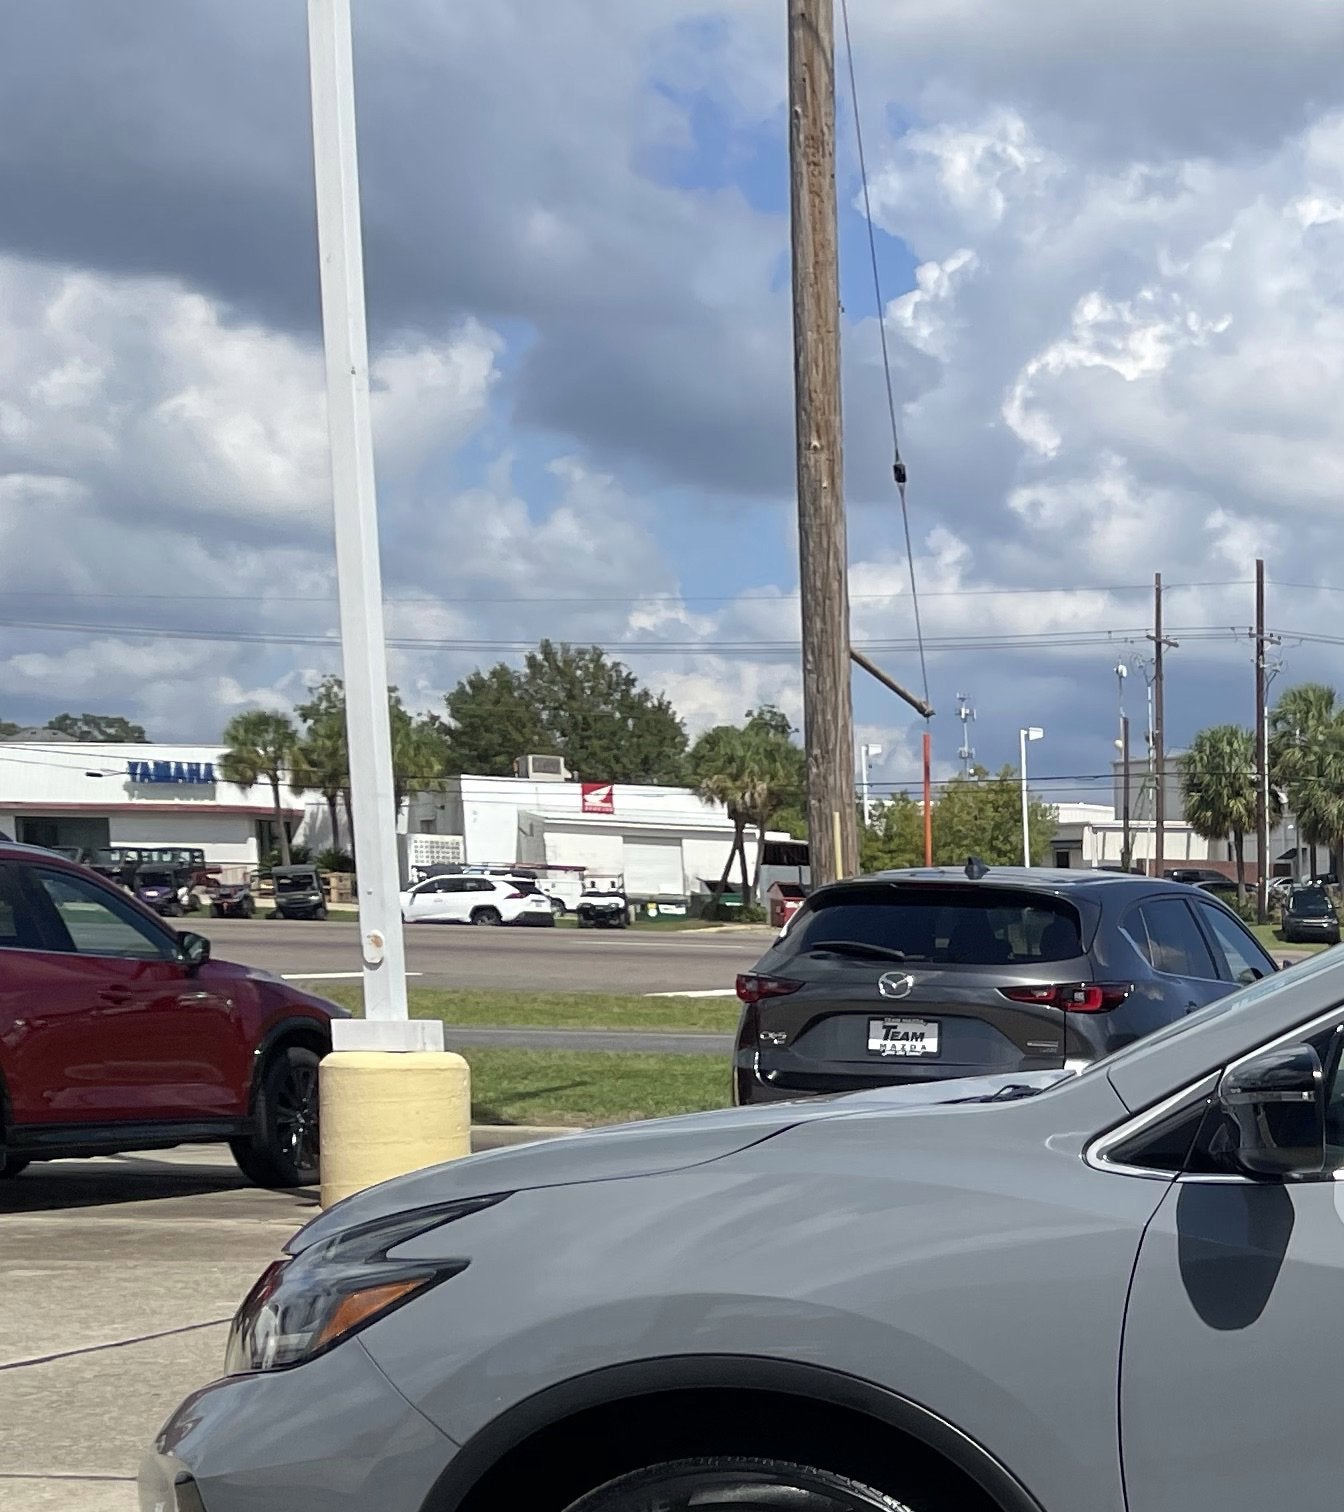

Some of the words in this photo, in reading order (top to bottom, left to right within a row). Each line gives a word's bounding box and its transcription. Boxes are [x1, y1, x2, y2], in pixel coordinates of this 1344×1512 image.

[126, 760, 215, 785] YAMAHA
[882, 1024, 926, 1042] TEAM
[880, 1043, 927, 1051] MAZDA
